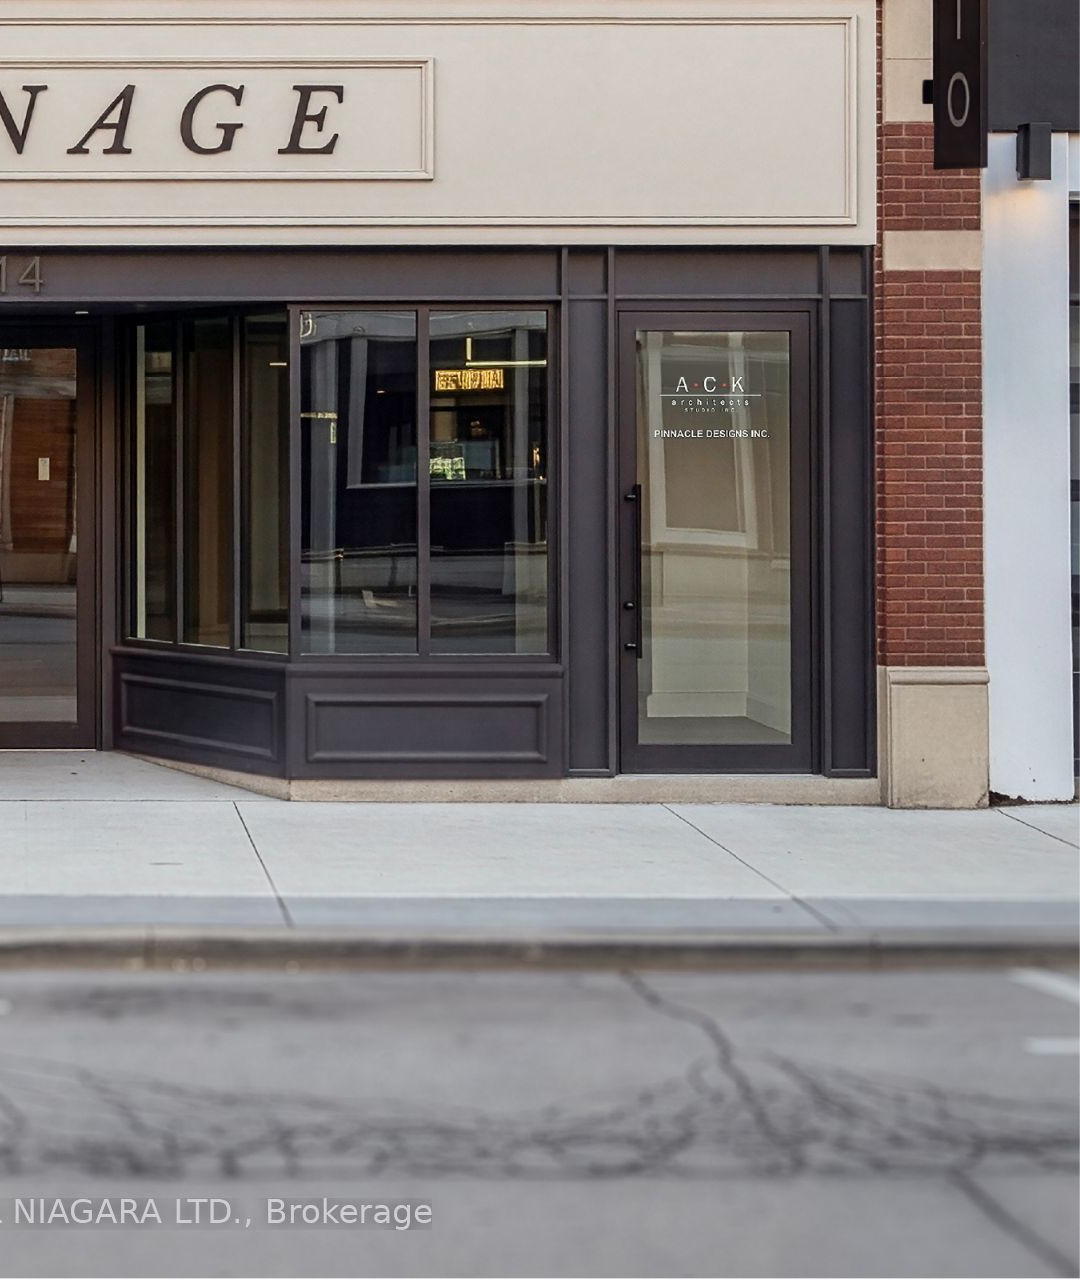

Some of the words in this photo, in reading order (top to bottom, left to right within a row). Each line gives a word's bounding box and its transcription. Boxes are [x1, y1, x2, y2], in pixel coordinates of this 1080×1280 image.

[671, 398, 750, 406] architects
[654, 429, 704, 438] PINNACLE
[706, 429, 749, 438] DESIGNS
[751, 429, 771, 438] INC.
